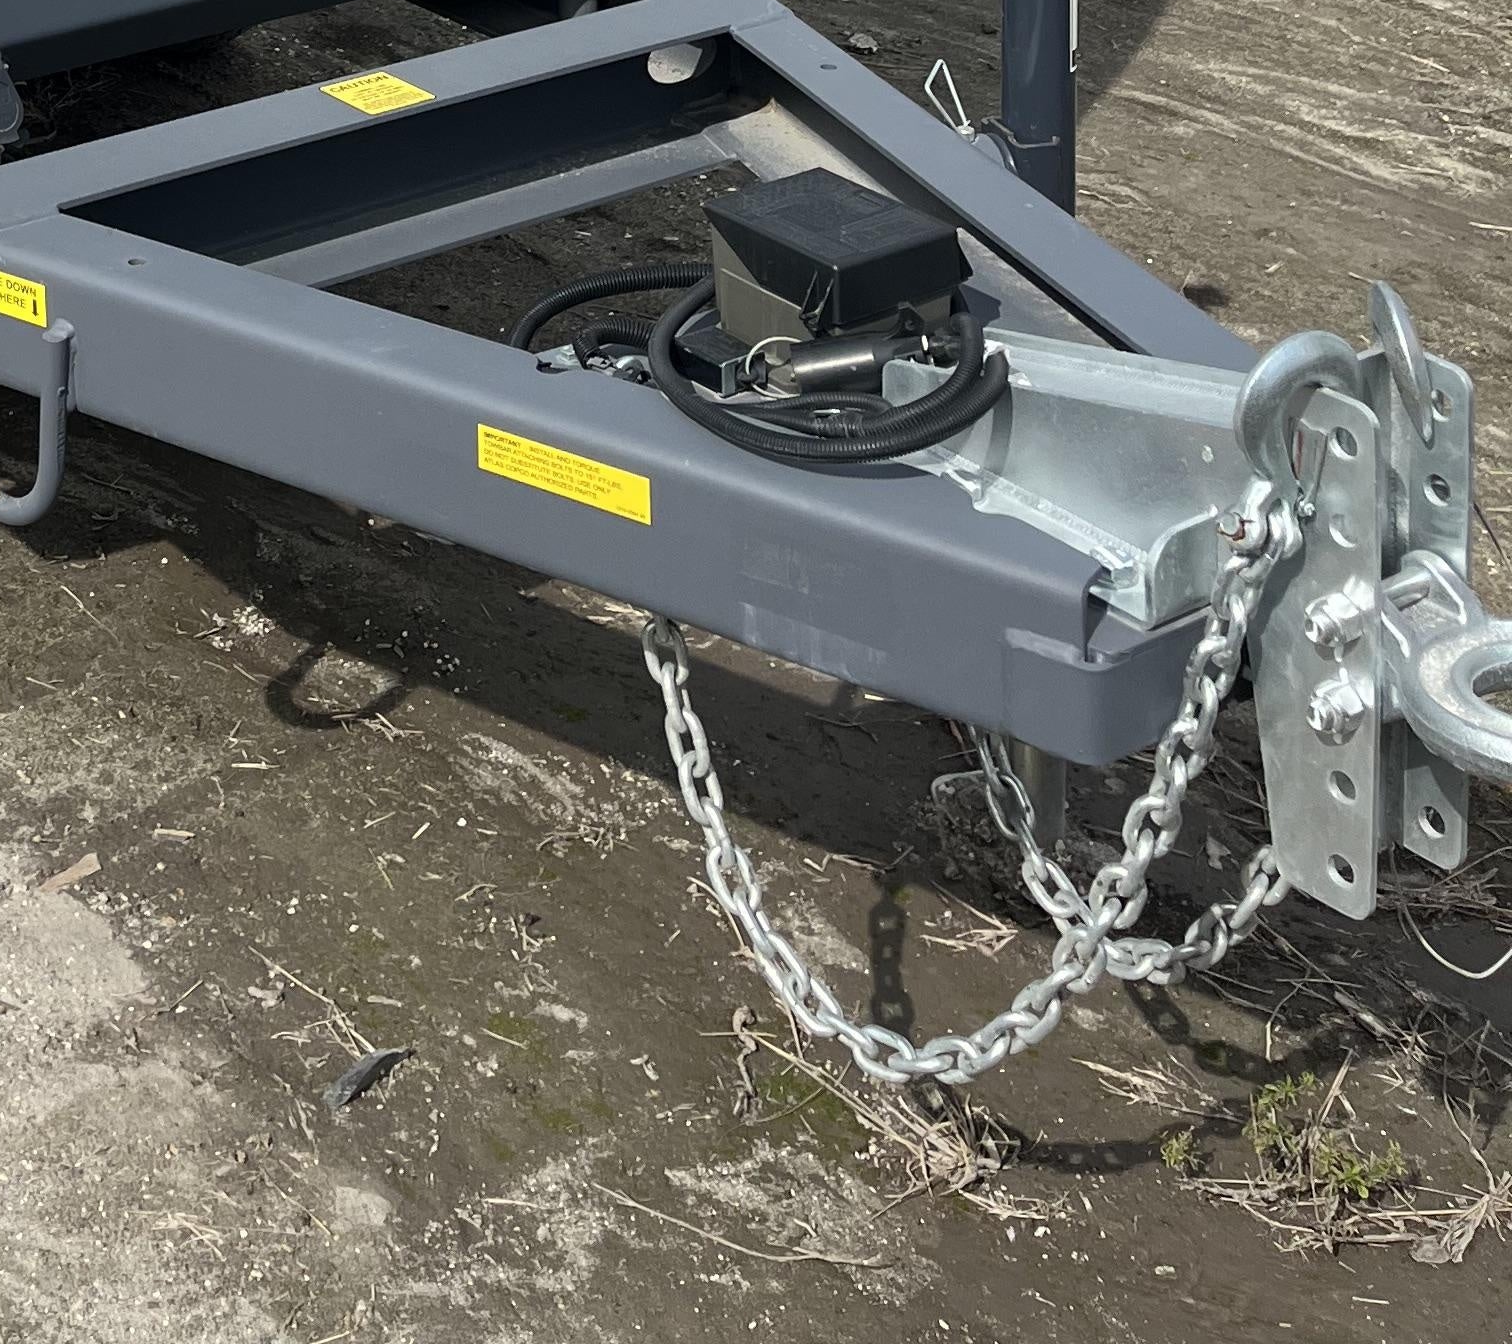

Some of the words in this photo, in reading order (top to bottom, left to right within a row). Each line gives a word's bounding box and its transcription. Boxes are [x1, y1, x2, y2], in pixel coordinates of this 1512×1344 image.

[329, 75, 390, 93] CAUTION
[5, 279, 37, 297] DOWN
[0, 292, 27, 309] HERE
[483, 431, 521, 448] IMPORTANT
[483, 448, 494, 457] DO
[484, 457, 504, 469] ATLAS
[506, 463, 530, 476] COPCO
[551, 461, 573, 473] BOLTS
[575, 468, 584, 477] TO
